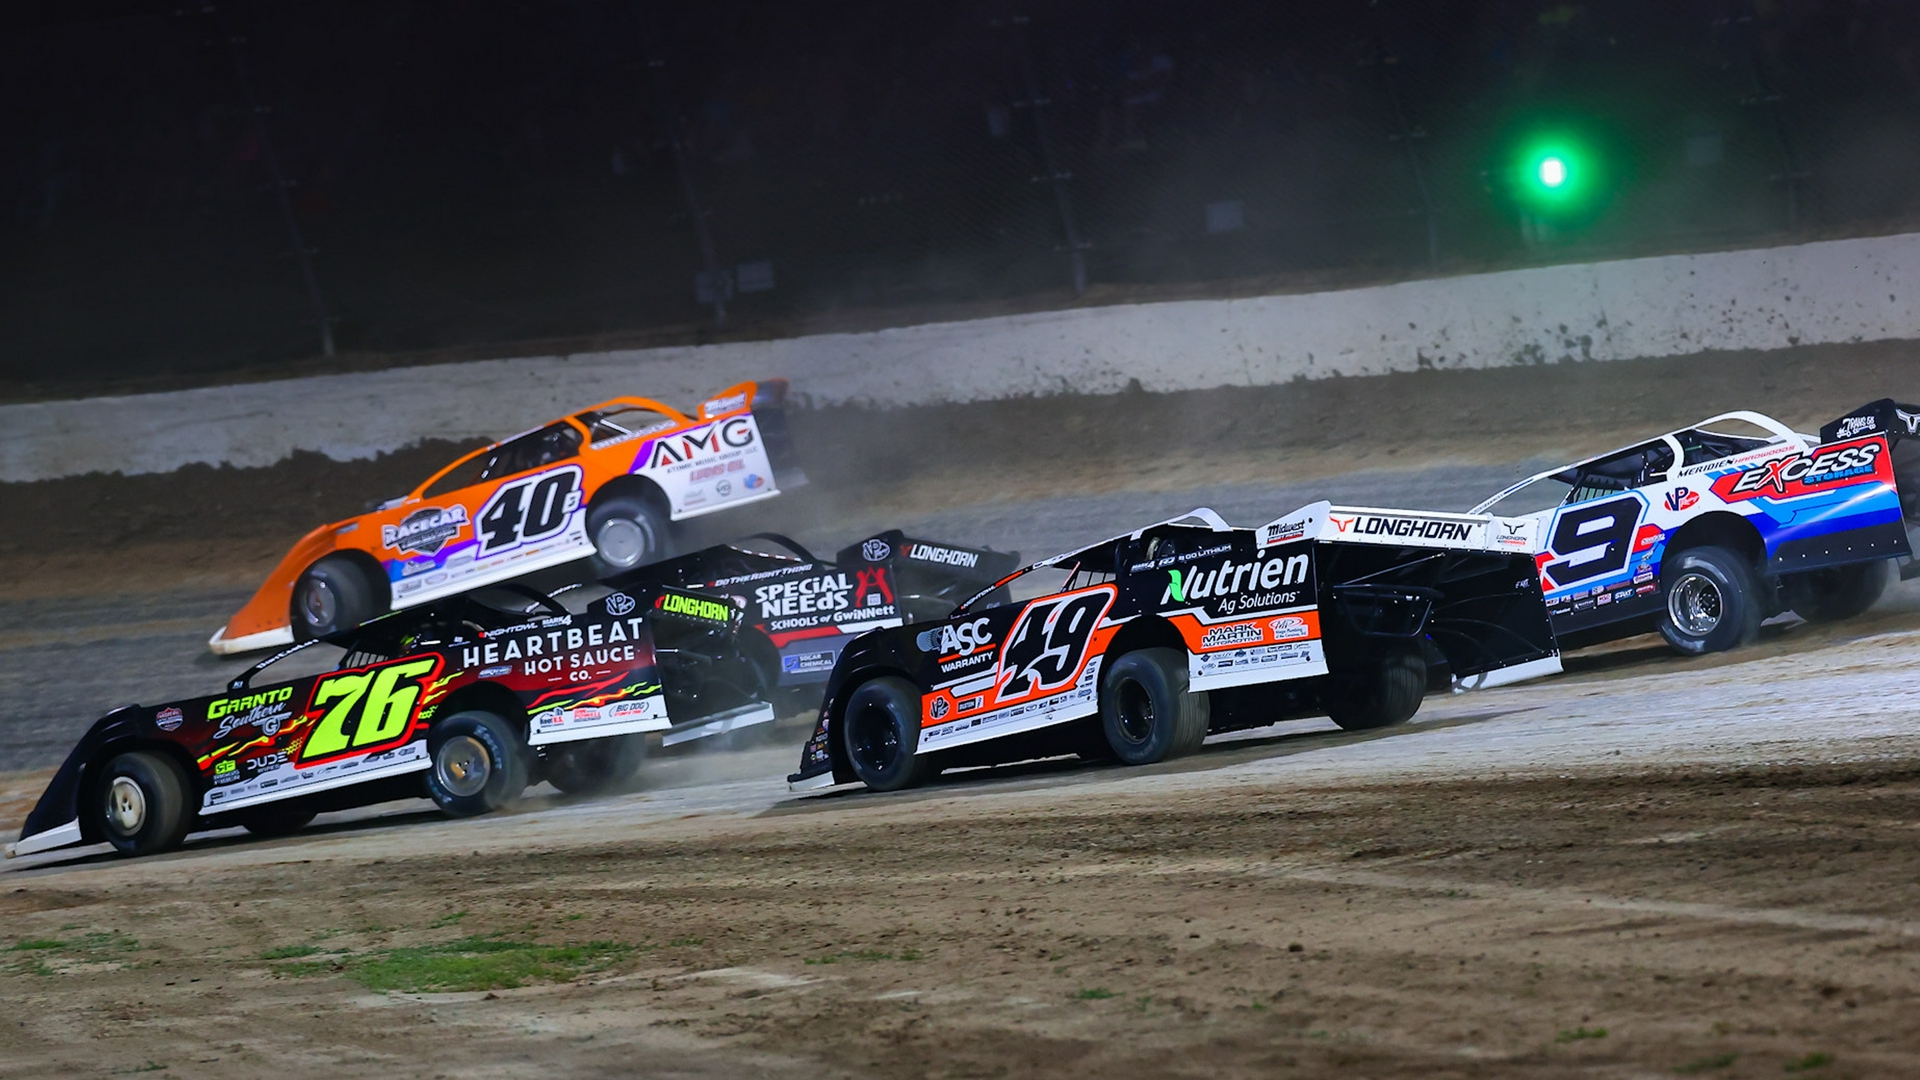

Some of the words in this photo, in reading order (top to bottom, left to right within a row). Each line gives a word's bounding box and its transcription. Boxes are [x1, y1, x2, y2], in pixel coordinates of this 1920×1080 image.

[651, 419, 755, 469] AMG
[1677, 458, 1736, 478] MERIDIEN
[1734, 445, 1795, 464] HARDWOODS
[1732, 443, 1880, 492] EXCESS
[1804, 465, 1873, 484] STORAGE
[481, 470, 578, 552] 40
[1665, 487, 1689, 512] VP
[384, 508, 466, 544] RACECAR
[1267, 519, 1305, 536] Midwest
[1353, 516, 1472, 541] LONGHORN
[1496, 534, 1527, 542] LONGHORN
[862, 539, 882, 561] VP
[1198, 544, 1232, 557] LITHIUM
[1545, 496, 1643, 586] 9
[910, 543, 978, 568] LONGHORN
[750, 569, 781, 580] RIGHT
[782, 563, 813, 575] THING
[1160, 550, 1309, 605] Nutrien
[663, 593, 729, 621] LONGHORN
[1218, 599, 1237, 614] Ag
[1239, 591, 1296, 610] Solutions
[484, 622, 539, 637] NIGHTOWL
[771, 616, 818, 631] SCHOOLS
[820, 615, 831, 623] of
[1209, 623, 1255, 636] MARK
[463, 617, 643, 669] HEARTBEAT
[941, 617, 993, 656] ASC
[1000, 592, 1112, 698] 49
[1202, 629, 1262, 643] MARTIN
[1202, 636, 1262, 648] AUTOMOTIVE
[524, 656, 564, 676] HOT
[570, 645, 635, 668] SAUCE
[800, 659, 832, 668] CHEMICAL
[940, 651, 994, 673] WARRANTY
[569, 670, 592, 682] CO.
[207, 687, 293, 719] GARNTO
[302, 659, 435, 759] 76
[630, 702, 645, 711] DOG
[930, 695, 944, 718] VP
[213, 702, 287, 739] Southern
[246, 751, 288, 771] DUDE
